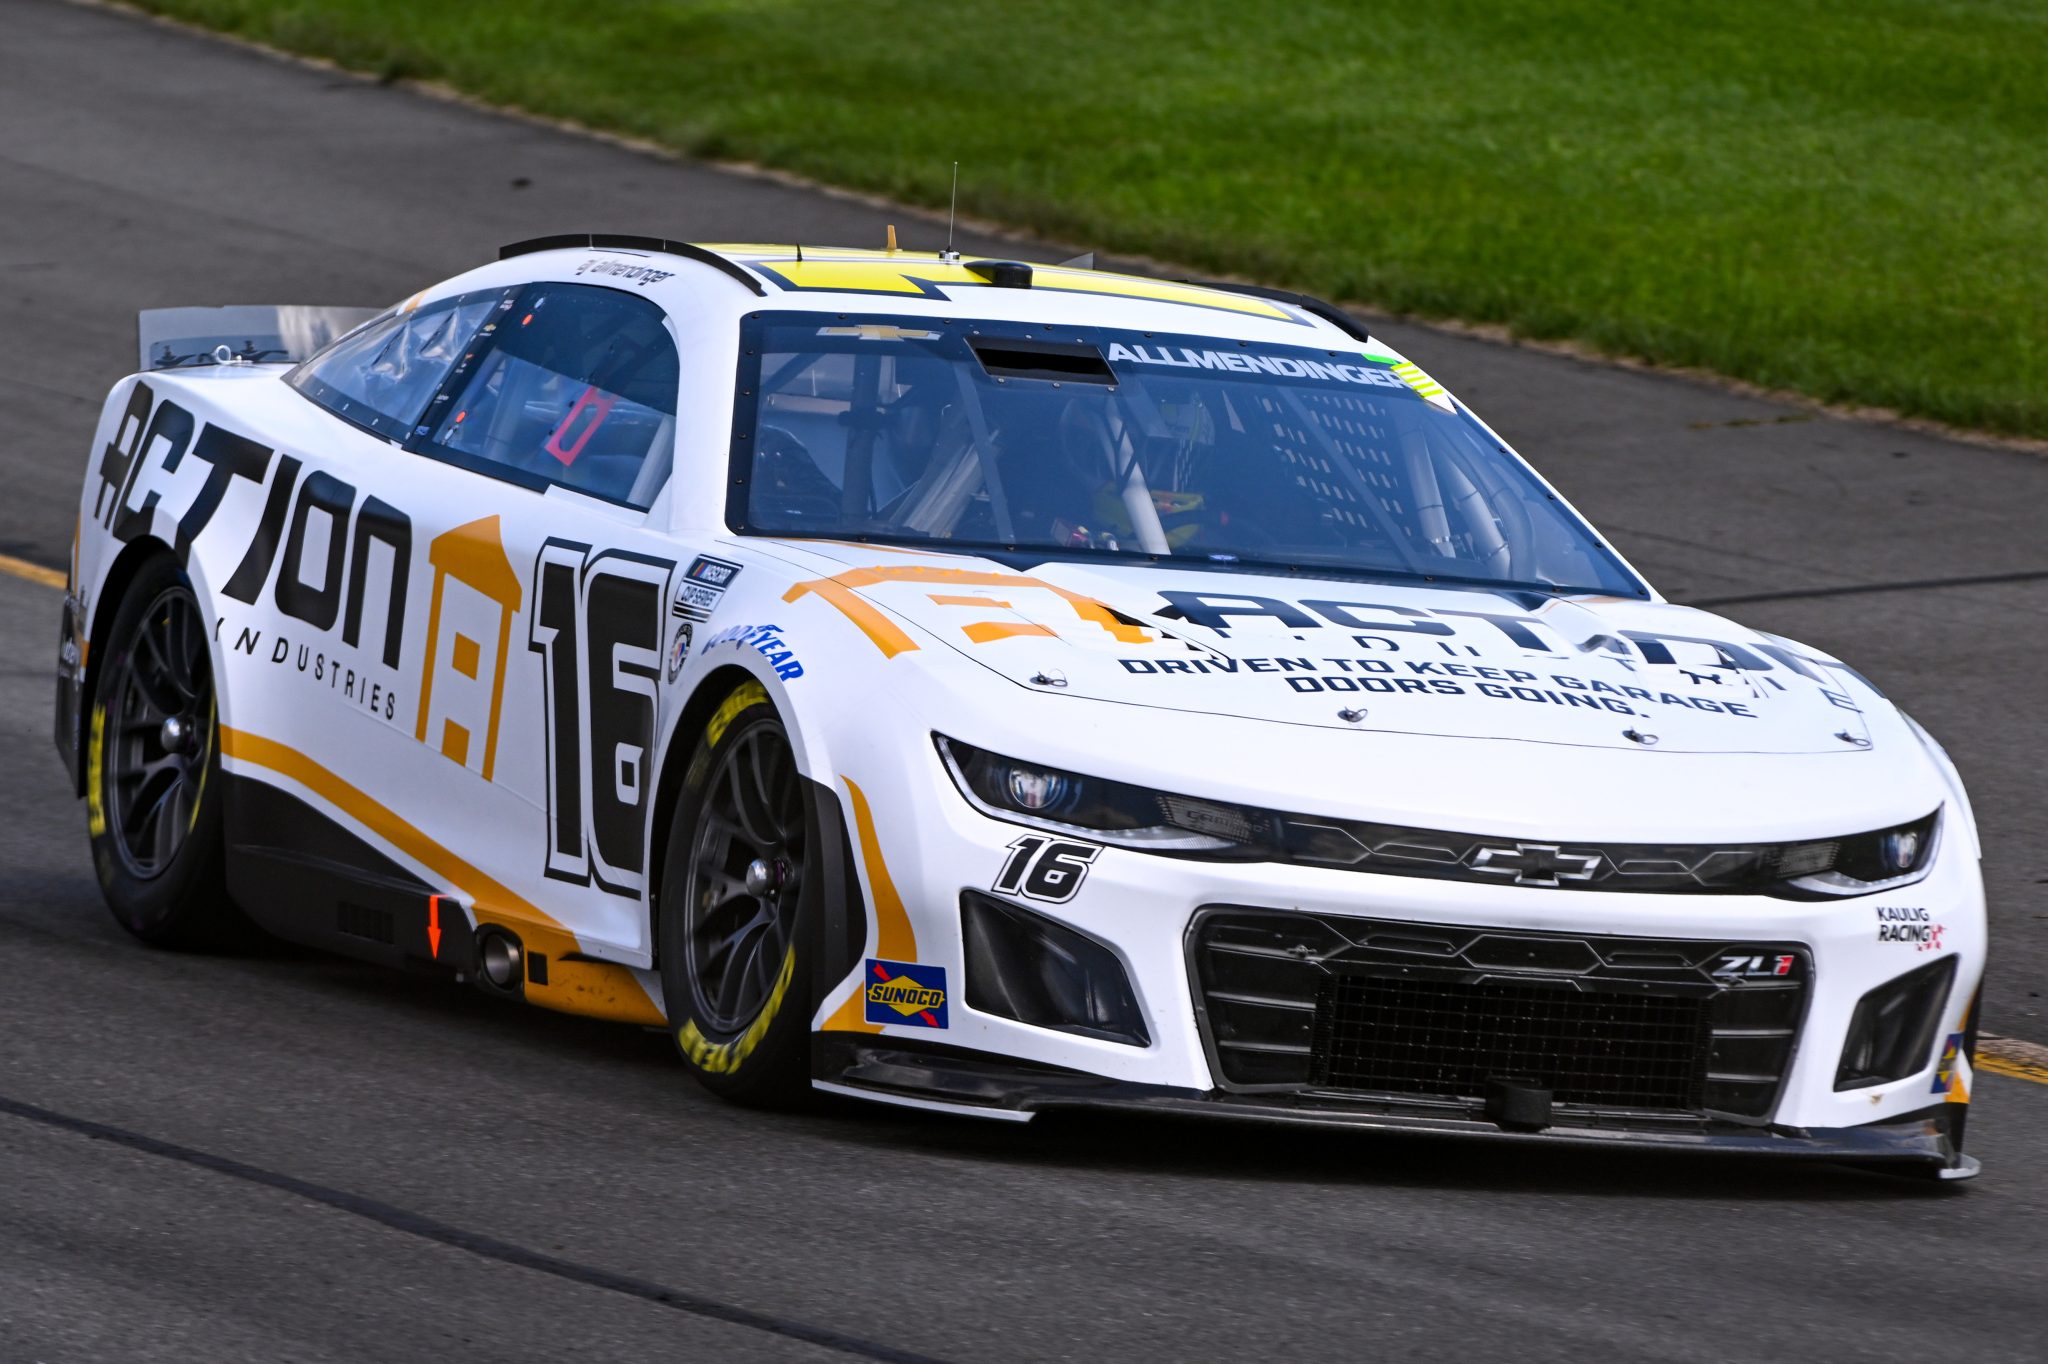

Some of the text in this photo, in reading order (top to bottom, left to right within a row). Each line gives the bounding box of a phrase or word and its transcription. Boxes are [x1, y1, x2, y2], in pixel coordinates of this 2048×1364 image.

[1108, 342, 1408, 389] ALLMENDINGER
[215, 616, 396, 720] INDUSTRIES
[1118, 657, 1318, 674] DRIVEN
[1323, 658, 1395, 673] TO
[1404, 661, 1537, 683] KEEP
[1550, 674, 1759, 718] GARAGE
[529, 536, 677, 901] 16
[1284, 676, 1466, 695] DOORS
[1474, 682, 1651, 719] GOING.
[991, 833, 1104, 905] 16
[1876, 906, 1930, 922] KAULIG
[1878, 924, 1931, 942] RACING
[1712, 955, 1795, 977] ZL1
[871, 985, 944, 1009] SUNOCO
